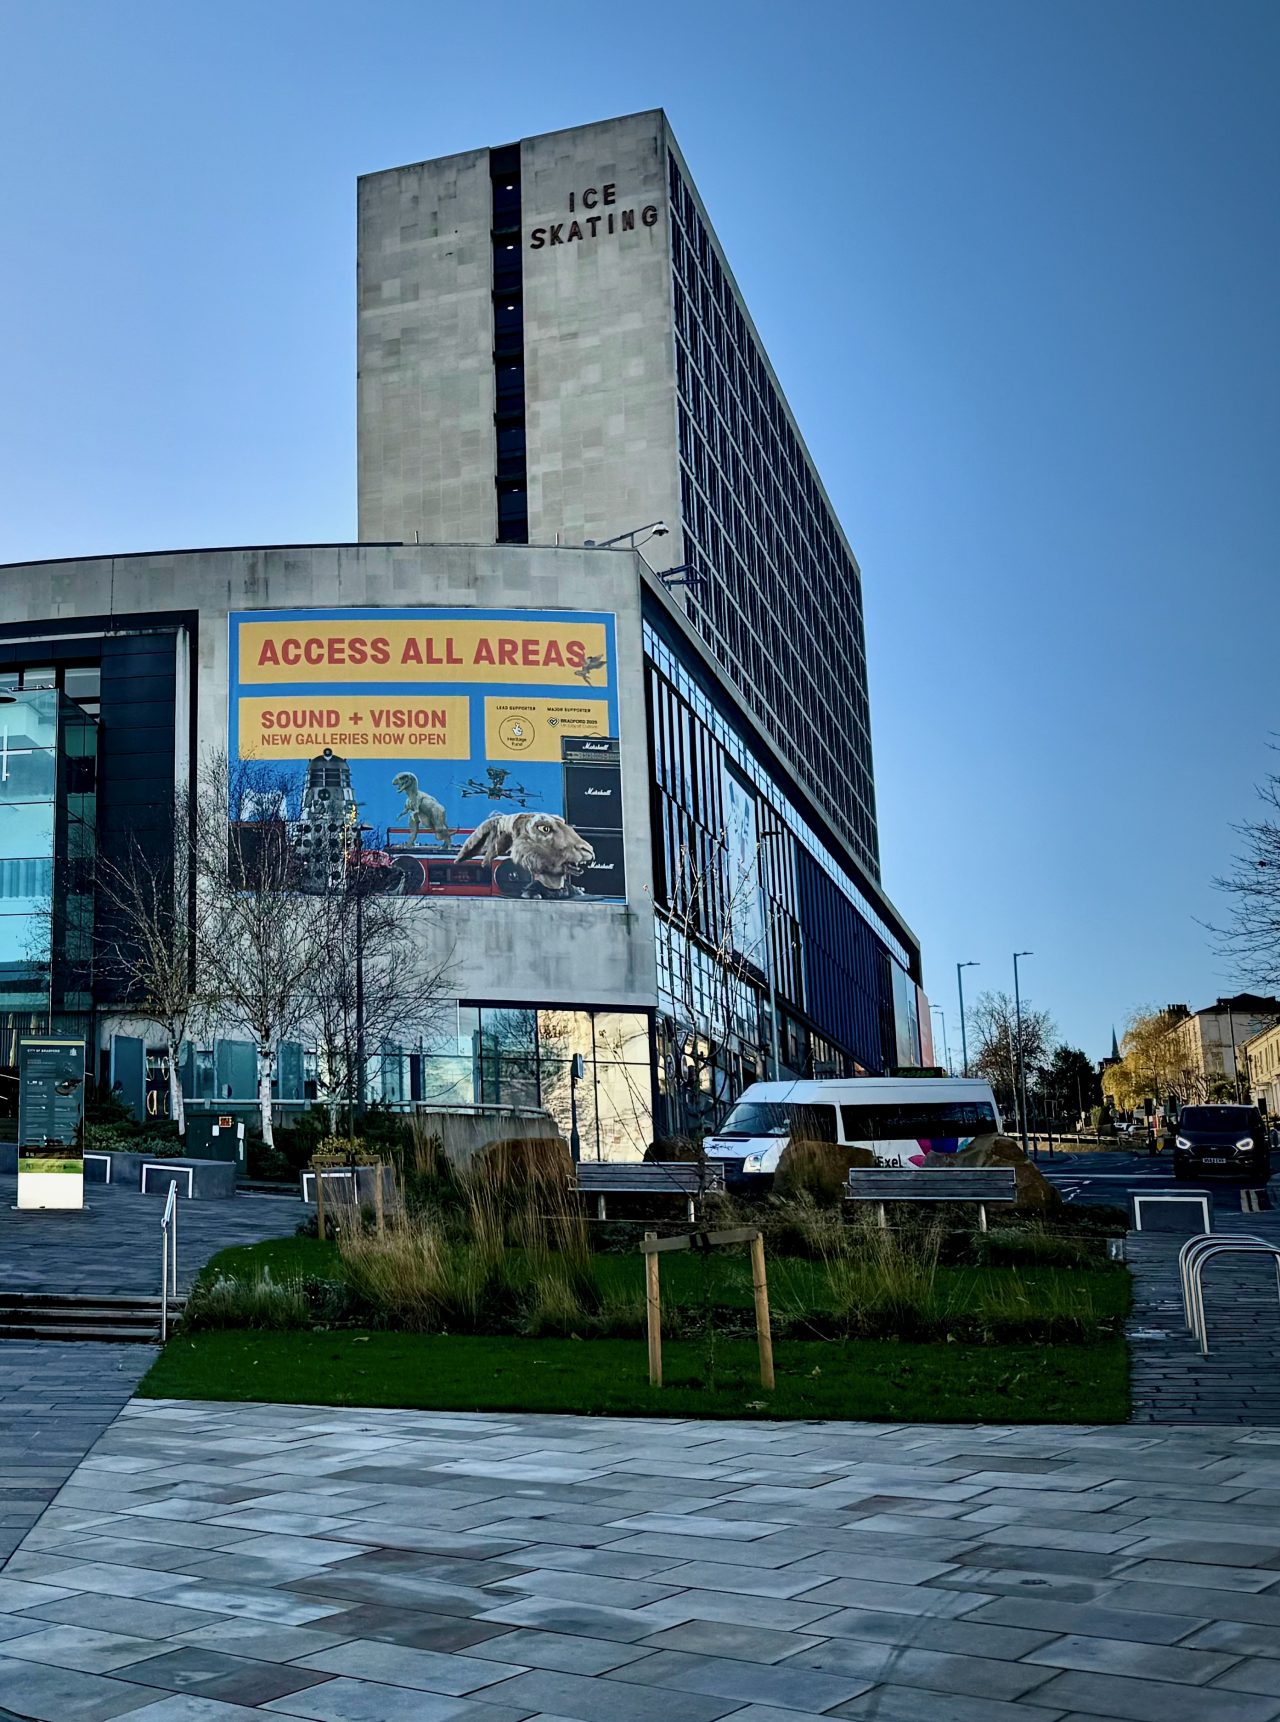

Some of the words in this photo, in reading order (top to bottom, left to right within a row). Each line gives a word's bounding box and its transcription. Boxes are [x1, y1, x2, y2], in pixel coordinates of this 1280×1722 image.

[569, 183, 616, 213] ICE
[530, 205, 658, 249] SKATING
[258, 637, 391, 666] ACCESS
[401, 637, 464, 665] ALL
[473, 638, 587, 669] AREAS
[261, 709, 341, 729] SOUND
[348, 711, 364, 726] +
[369, 709, 447, 729] VISION
[261, 733, 294, 746] NEW
[295, 732, 370, 746] GALLERIES
[372, 732, 406, 746] NOW
[408, 732, 447, 746] OPEN
